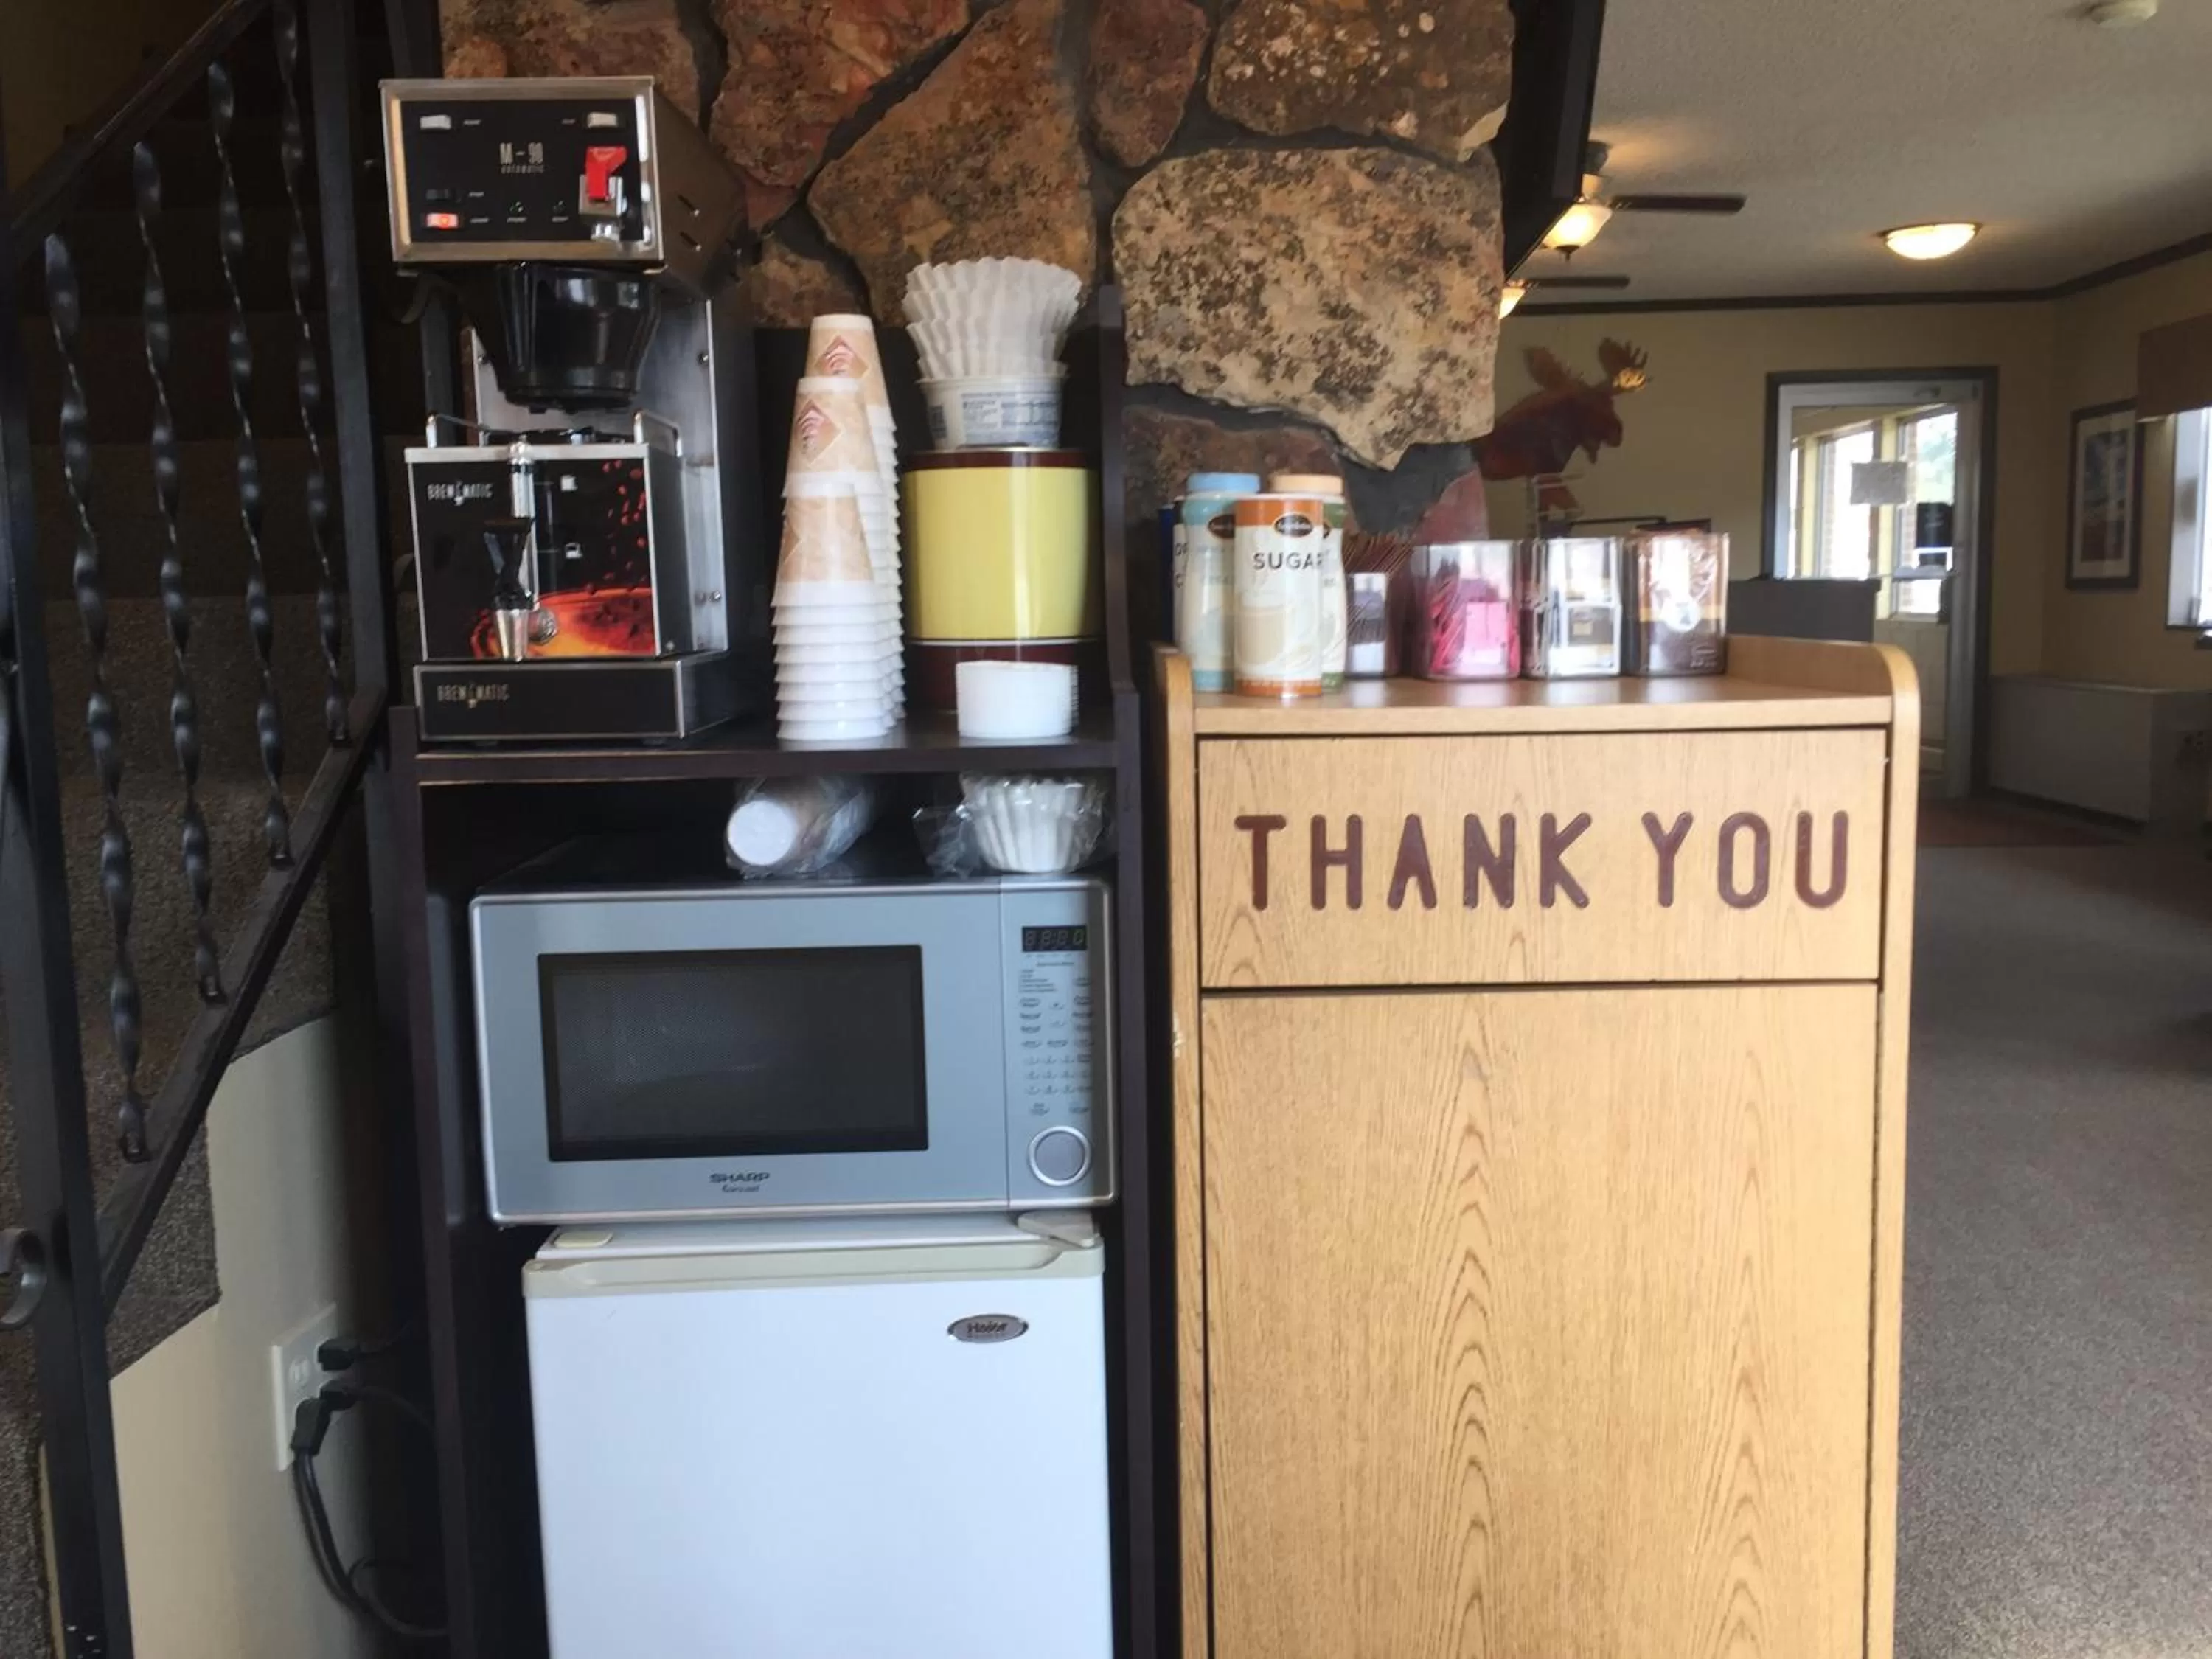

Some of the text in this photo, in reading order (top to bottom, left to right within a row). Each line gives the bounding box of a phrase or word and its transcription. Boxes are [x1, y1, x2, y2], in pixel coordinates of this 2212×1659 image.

[1234, 810, 1849, 910] THANK YOU
[709, 1172, 771, 1183] SHARP
